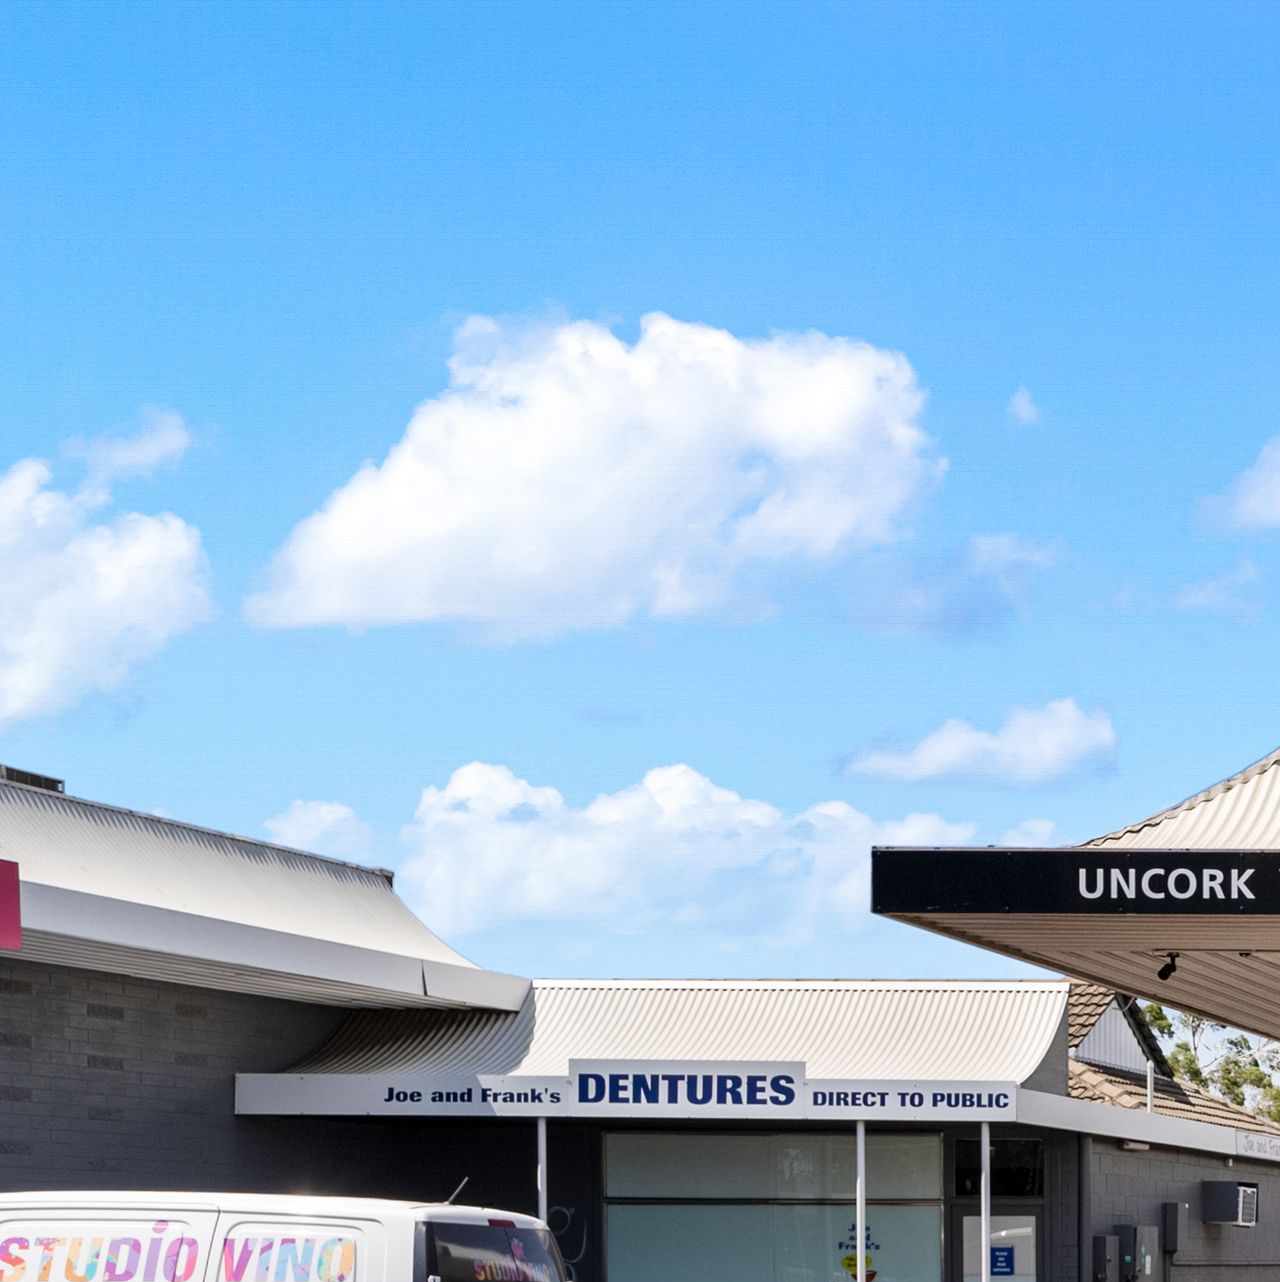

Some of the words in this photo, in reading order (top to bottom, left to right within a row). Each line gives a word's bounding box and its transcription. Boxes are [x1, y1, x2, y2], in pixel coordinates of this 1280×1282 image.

[1077, 867, 1255, 901] UNCORK
[384, 1087, 422, 1103] Joe
[431, 1088, 472, 1103] and
[481, 1087, 561, 1103] Frank's
[578, 1073, 795, 1106] DENTURES
[812, 1091, 889, 1106] DIRECT
[898, 1091, 924, 1107] TO
[932, 1092, 1010, 1108] PUBLIC
[848, 1223, 870, 1232] Je
[849, 1233, 870, 1241] ad
[838, 1242, 880, 1250] Frak's
